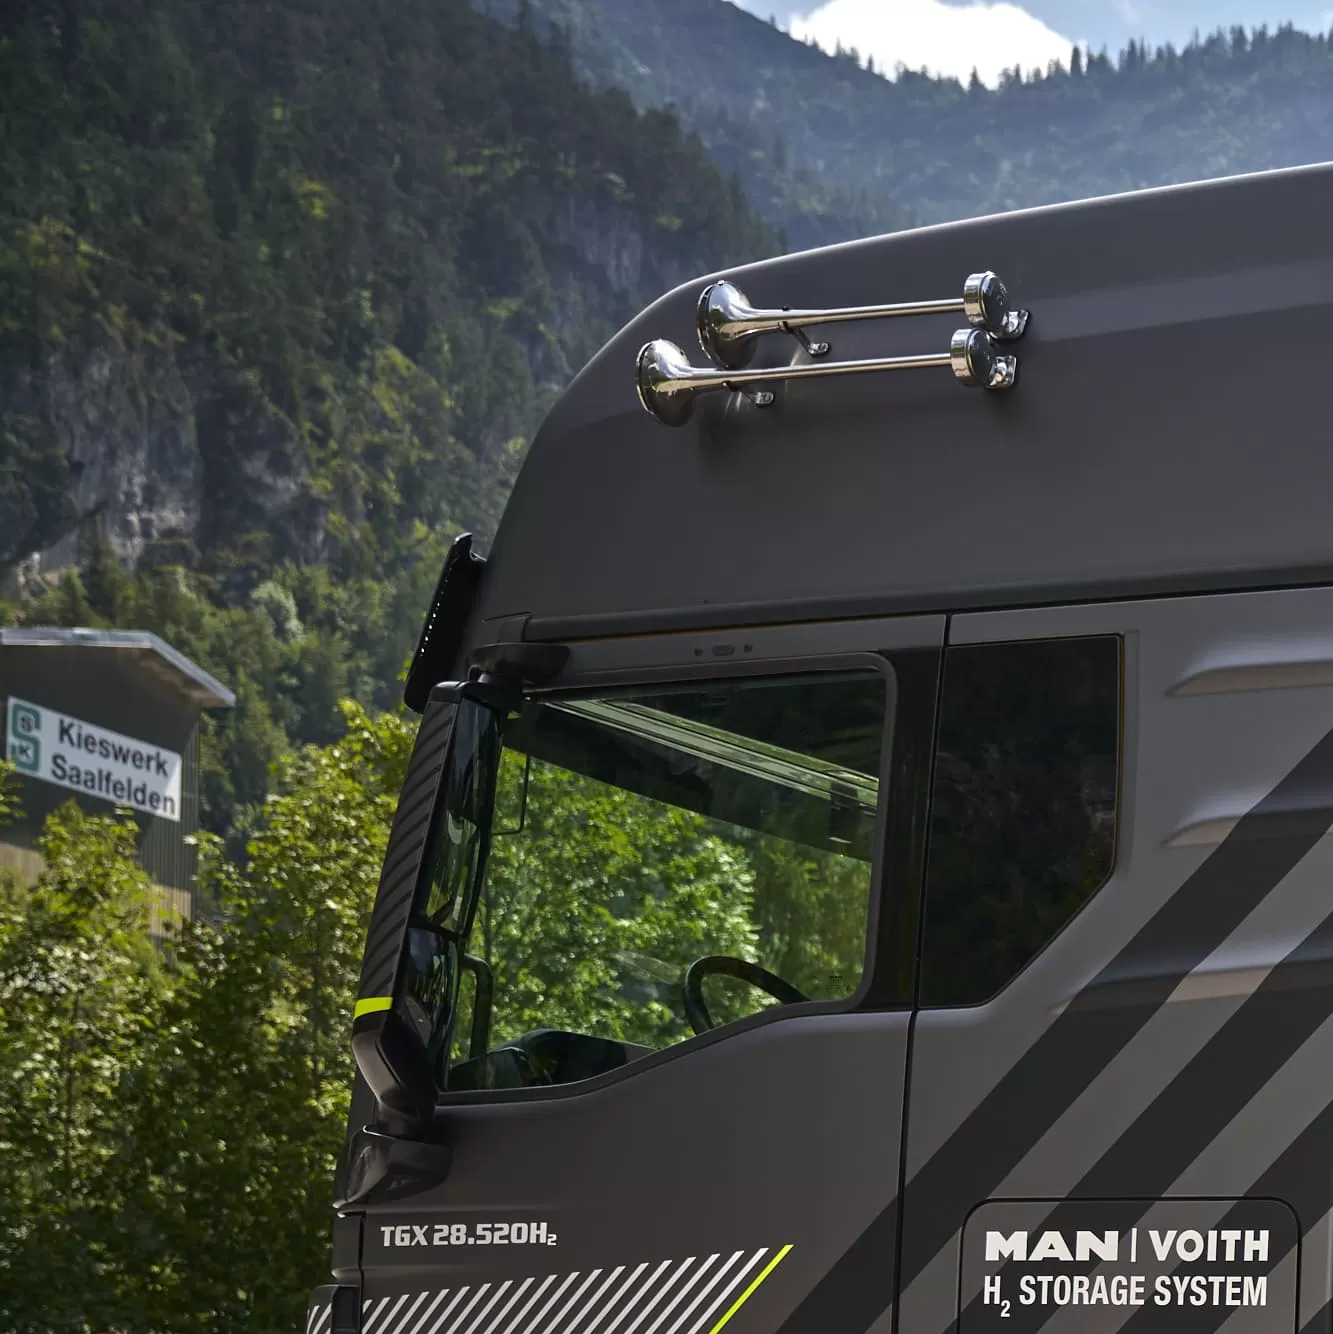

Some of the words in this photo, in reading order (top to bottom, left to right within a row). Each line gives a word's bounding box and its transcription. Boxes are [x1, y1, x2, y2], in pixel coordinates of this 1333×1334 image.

[58, 718, 170, 778] Kieswerk
[51, 752, 176, 815] Saalfelden
[380, 1224, 429, 1247] TGX
[985, 1229, 1120, 1262] MAN
[1148, 1229, 1270, 1262] VOITH
[1018, 1275, 1146, 1306] STORAGE
[1153, 1275, 1268, 1307] SYSTEM
